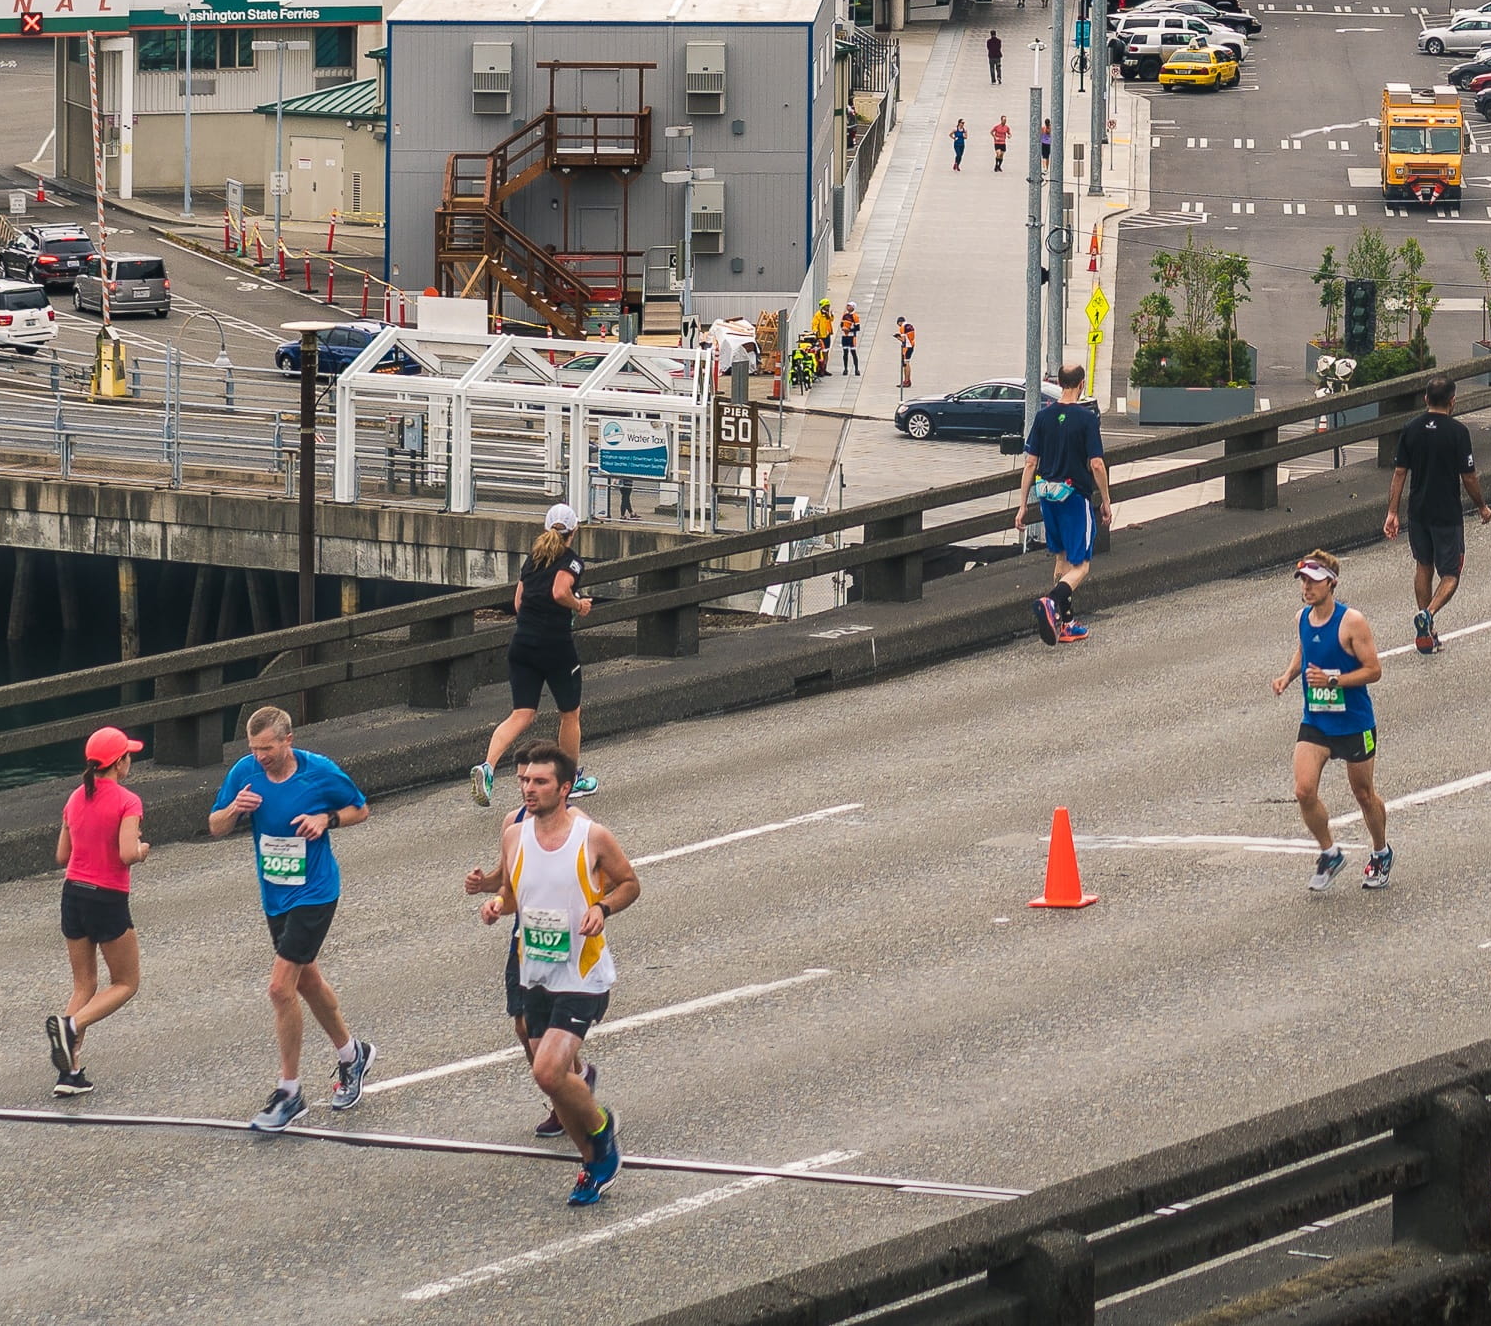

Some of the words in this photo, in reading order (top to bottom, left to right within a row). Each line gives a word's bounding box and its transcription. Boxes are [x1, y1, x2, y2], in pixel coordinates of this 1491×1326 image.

[247, 8, 278, 21] State
[280, 7, 320, 20] Ferries
[723, 407, 750, 418] PIER
[721, 417, 752, 443] 50
[627, 434, 650, 444] Water
[263, 857, 301, 872] 2056
[529, 930, 562, 946] 3107
